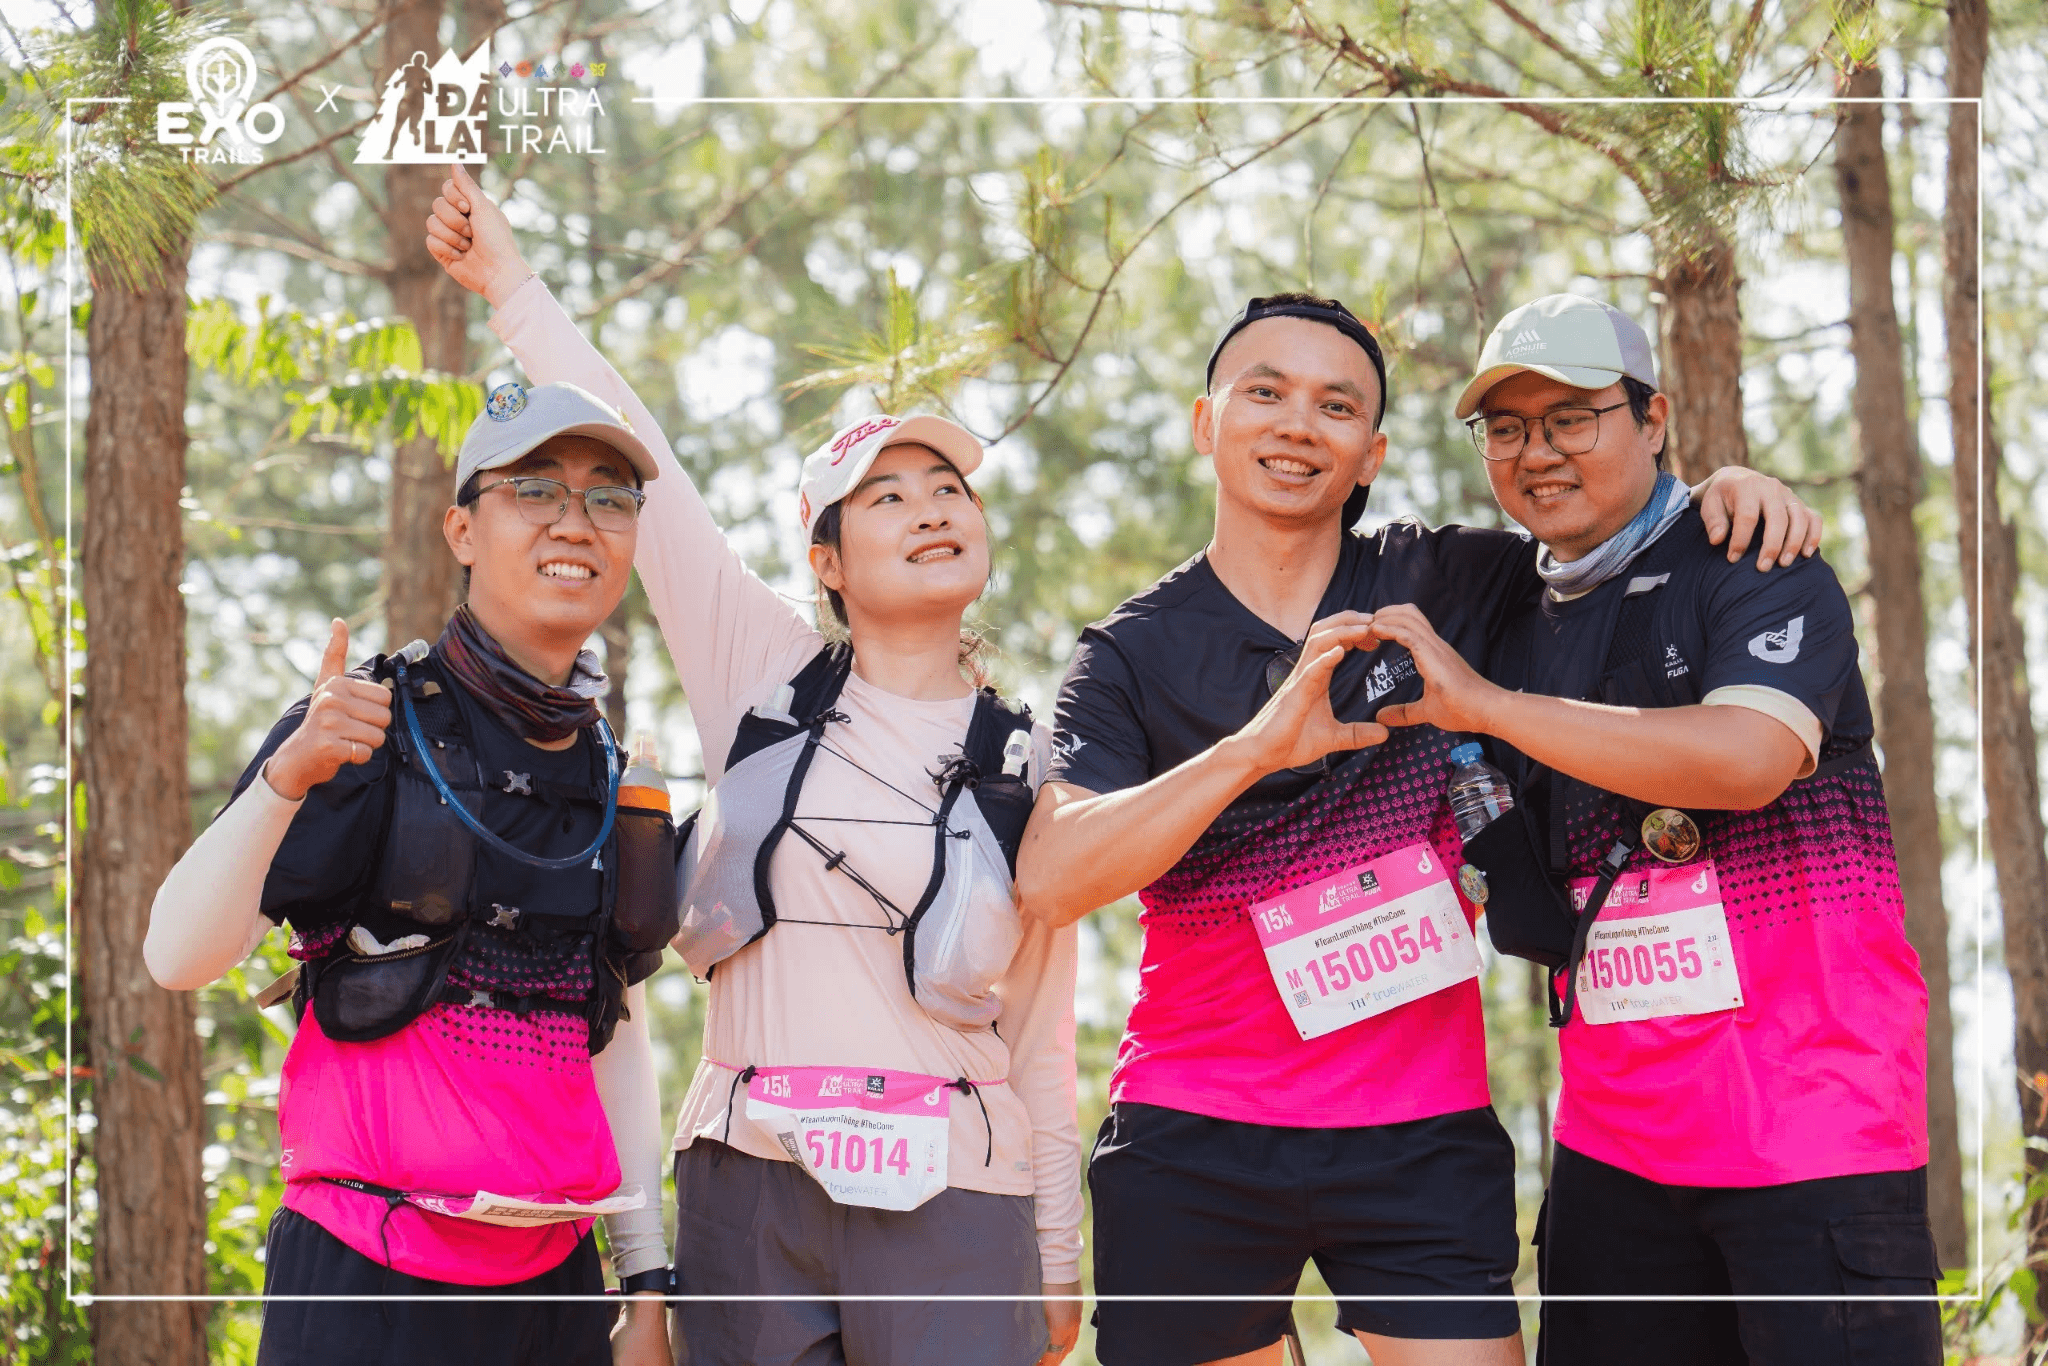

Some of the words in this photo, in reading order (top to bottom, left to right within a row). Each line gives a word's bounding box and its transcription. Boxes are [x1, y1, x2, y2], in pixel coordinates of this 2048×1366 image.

[1395, 670, 1417, 684] TRAIL
[1667, 665, 1690, 680] FUGA
[1373, 907, 1406, 927] #TheCone
[1285, 968, 1303, 990] M
[1305, 915, 1443, 998] 150054
[1587, 937, 1703, 990] 150055
[861, 1118, 895, 1131] #TheCone
